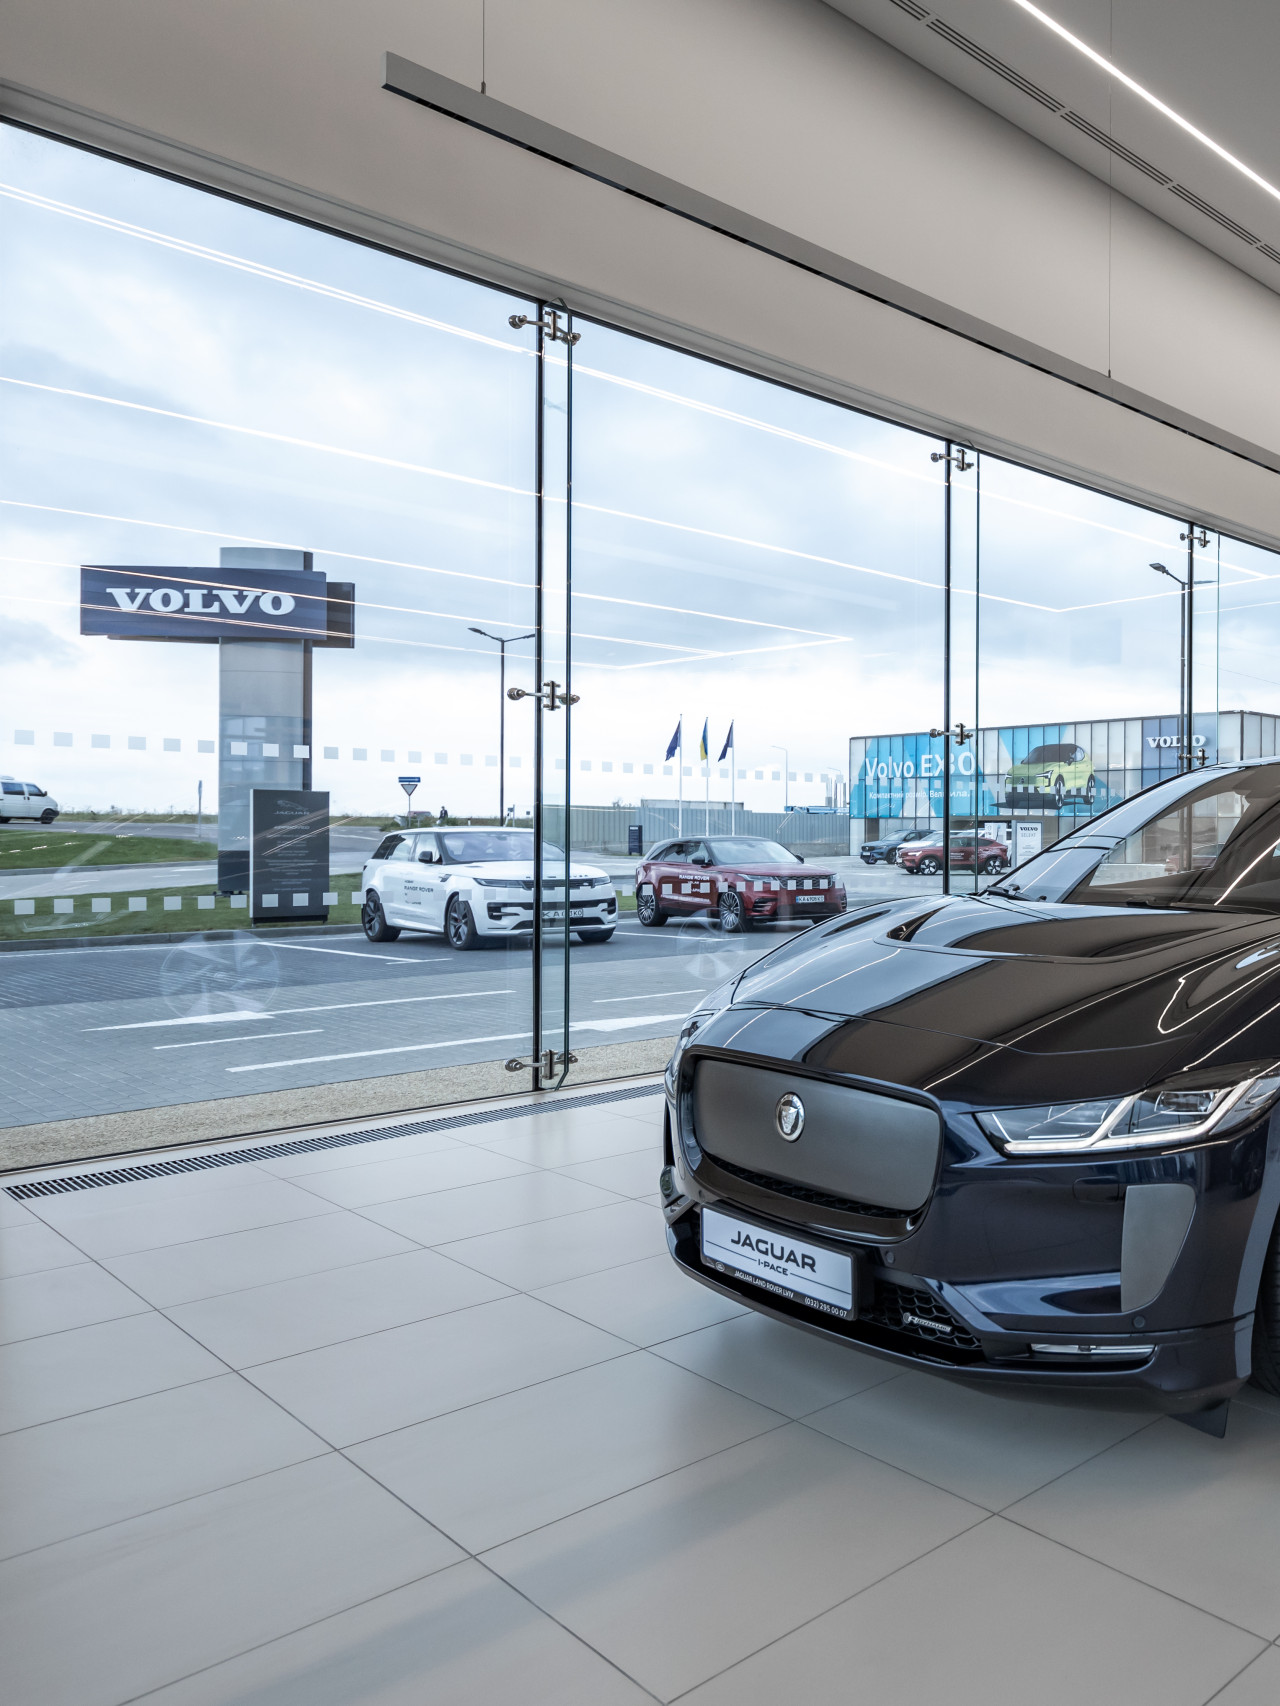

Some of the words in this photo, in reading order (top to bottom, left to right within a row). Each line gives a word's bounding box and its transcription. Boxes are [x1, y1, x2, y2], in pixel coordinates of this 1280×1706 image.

[106, 588, 295, 615] VOLVO
[865, 756, 914, 778] Volvo
[869, 791, 904, 799] Компактний
[731, 1231, 816, 1273] JAGUAR
[757, 1259, 788, 1276] I-PACE
[734, 1270, 752, 1282] JAGUAR
[752, 1276, 766, 1288] LAND
[766, 1281, 782, 1294] ROVER
[783, 1287, 794, 1298] LVIV
[805, 1296, 819, 1308] (032)
[819, 1302, 831, 1312] 295
[831, 1306, 839, 1315] 00
[839, 1309, 847, 1318] 07
